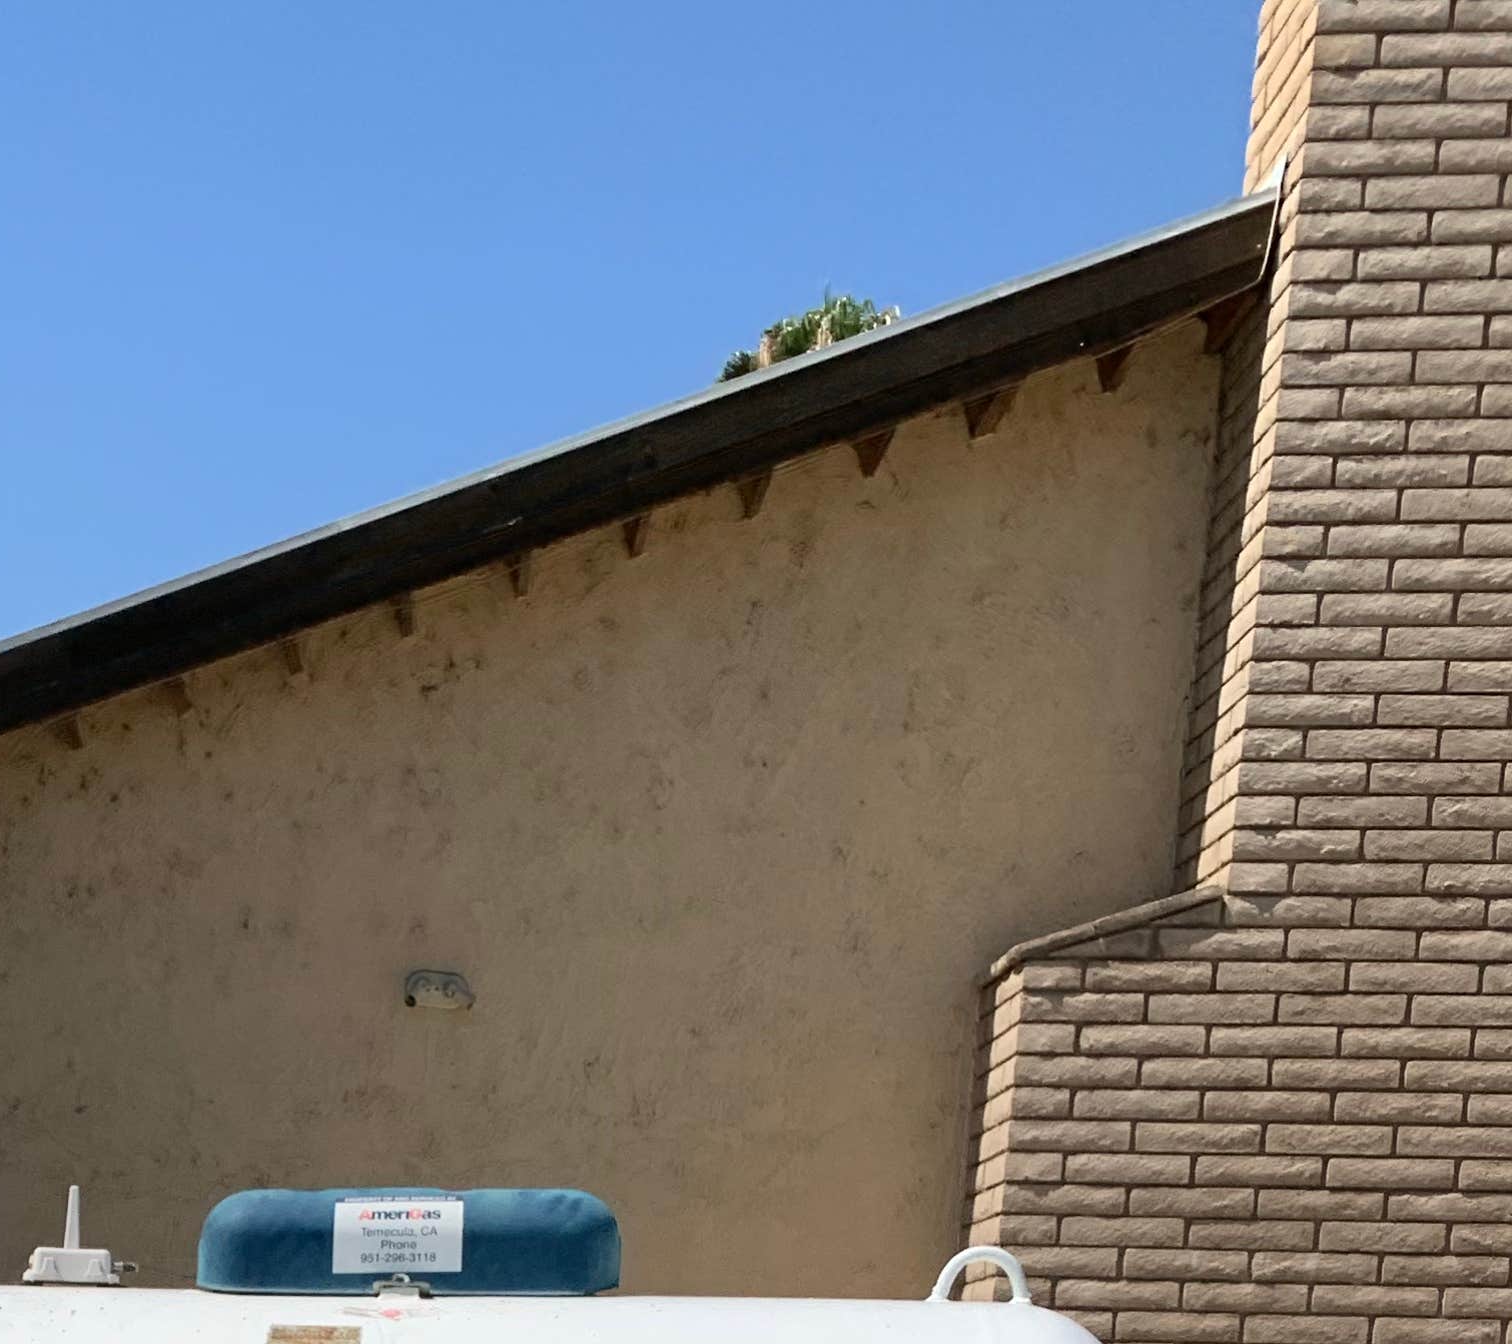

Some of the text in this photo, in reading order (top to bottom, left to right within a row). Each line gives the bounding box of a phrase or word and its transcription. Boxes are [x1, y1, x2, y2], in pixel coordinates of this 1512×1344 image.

[359, 1208, 442, 1221] AmeriGas
[361, 1226, 438, 1238] Temecula, CA
[380, 1240, 417, 1250] Phone
